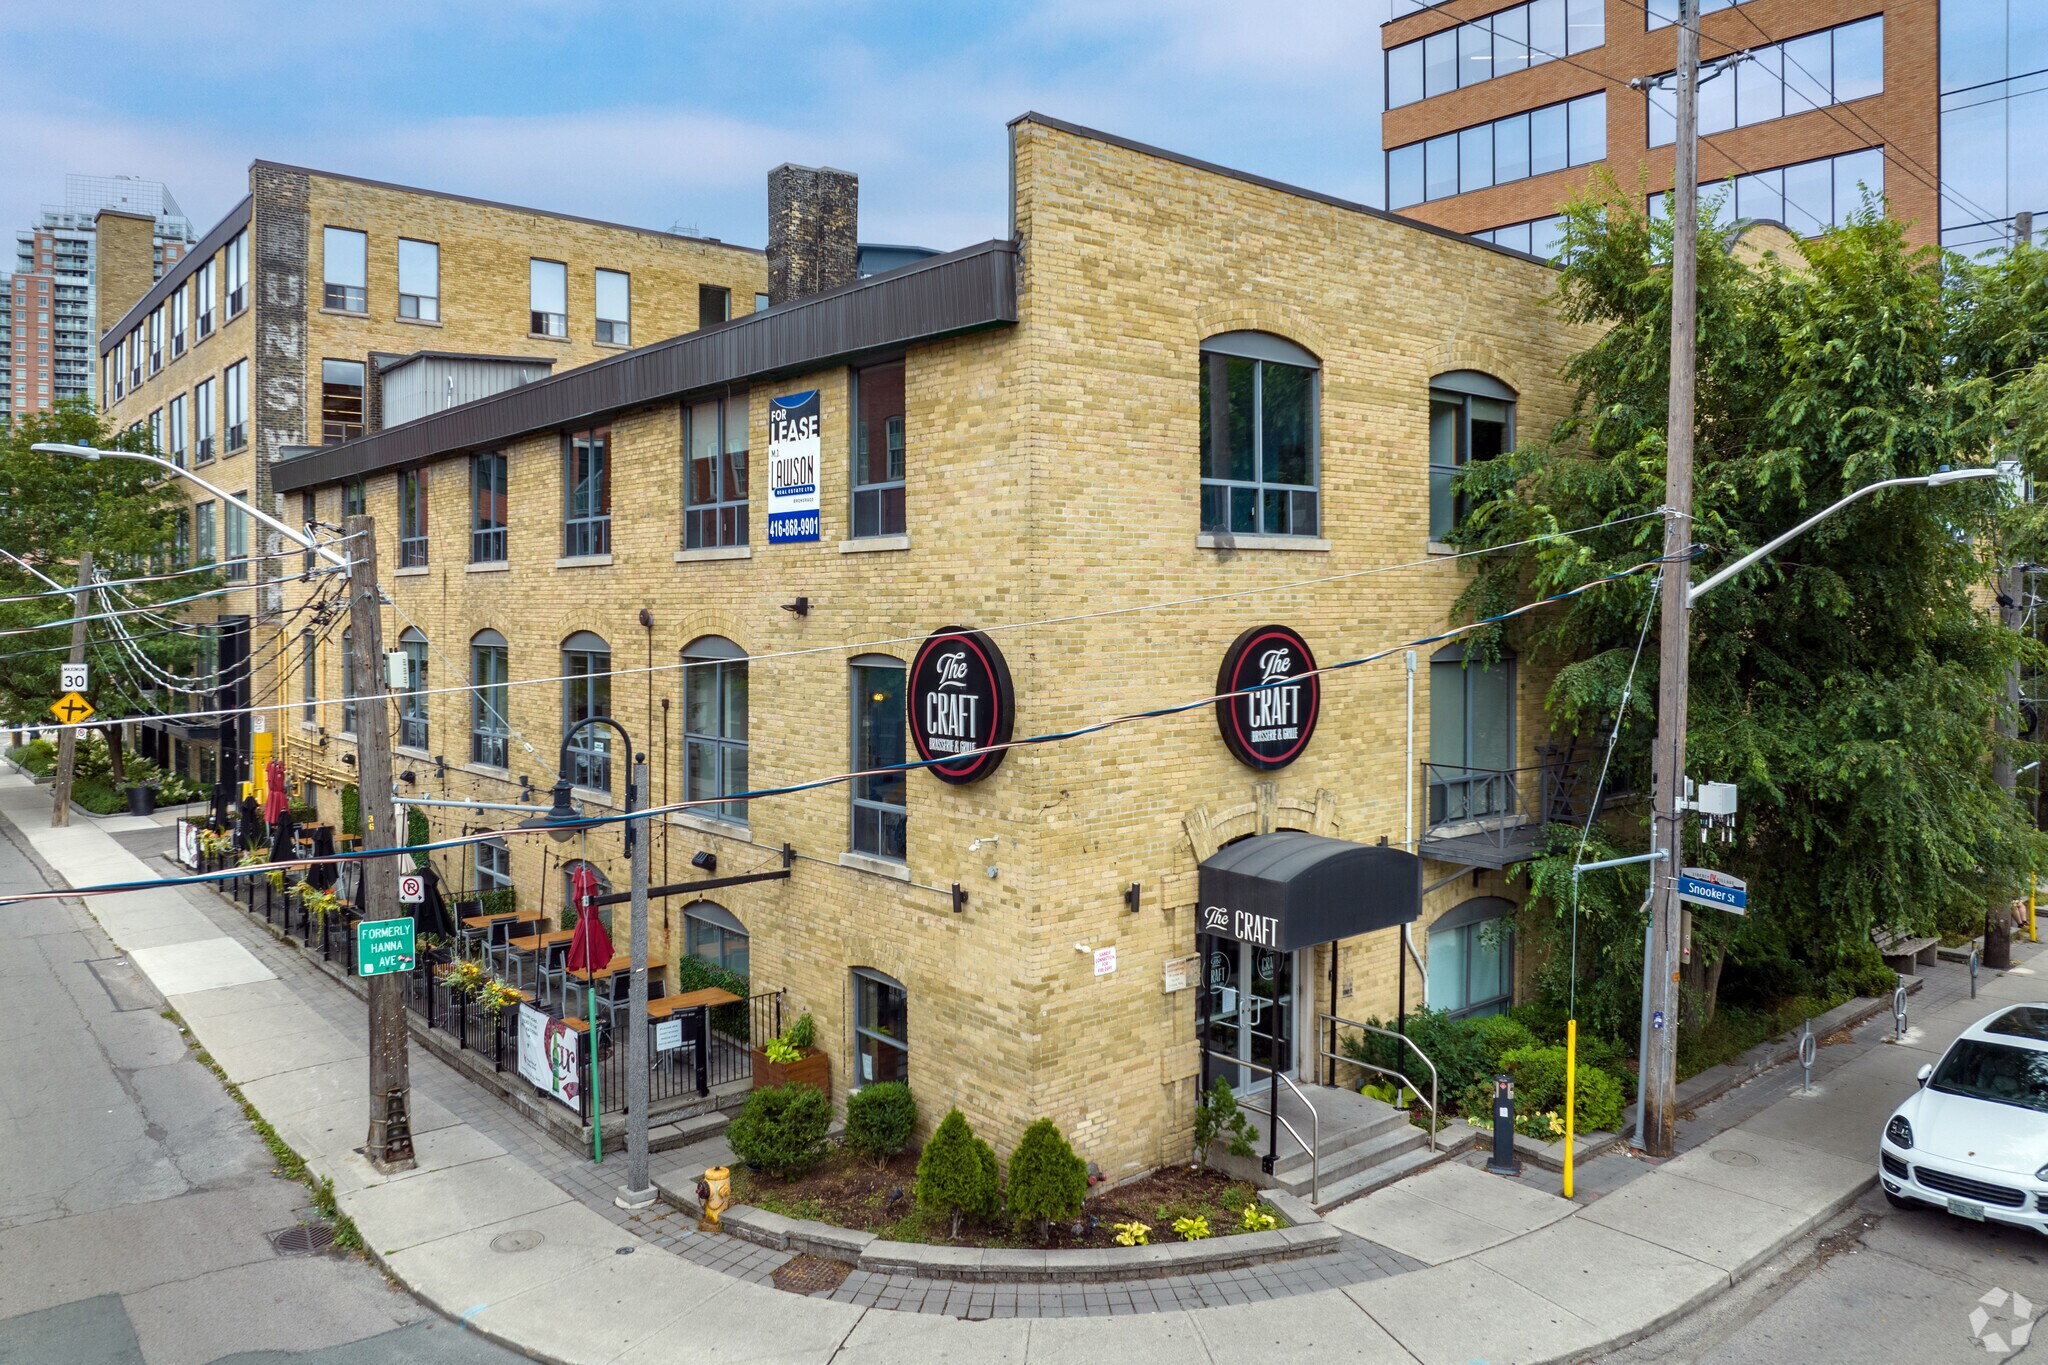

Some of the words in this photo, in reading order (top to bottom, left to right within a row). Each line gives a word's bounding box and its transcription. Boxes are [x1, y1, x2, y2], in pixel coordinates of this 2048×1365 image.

[771, 408, 787, 422] FOR
[771, 415, 818, 444] LEASE
[771, 455, 814, 491] LAWSON
[769, 516, 819, 538] 416-868-9901
[936, 652, 968, 685] The
[1259, 648, 1292, 680] The
[64, 675, 85, 688] 30
[926, 691, 979, 738] CRAFT
[1248, 685, 1302, 728] CRAFT
[1251, 728, 1277, 743] BRASSERIE
[1277, 728, 1283, 741] &
[954, 740, 960, 754] &
[1688, 882, 1727, 901] Snooker
[1727, 893, 1735, 903] St
[362, 924, 411, 940] FORMERLY
[1204, 906, 1229, 926] The
[1235, 910, 1279, 947] CRAFT
[371, 940, 403, 954] HANNA
[379, 955, 397, 967] AVE
[1211, 967, 1226, 984] RAFT
